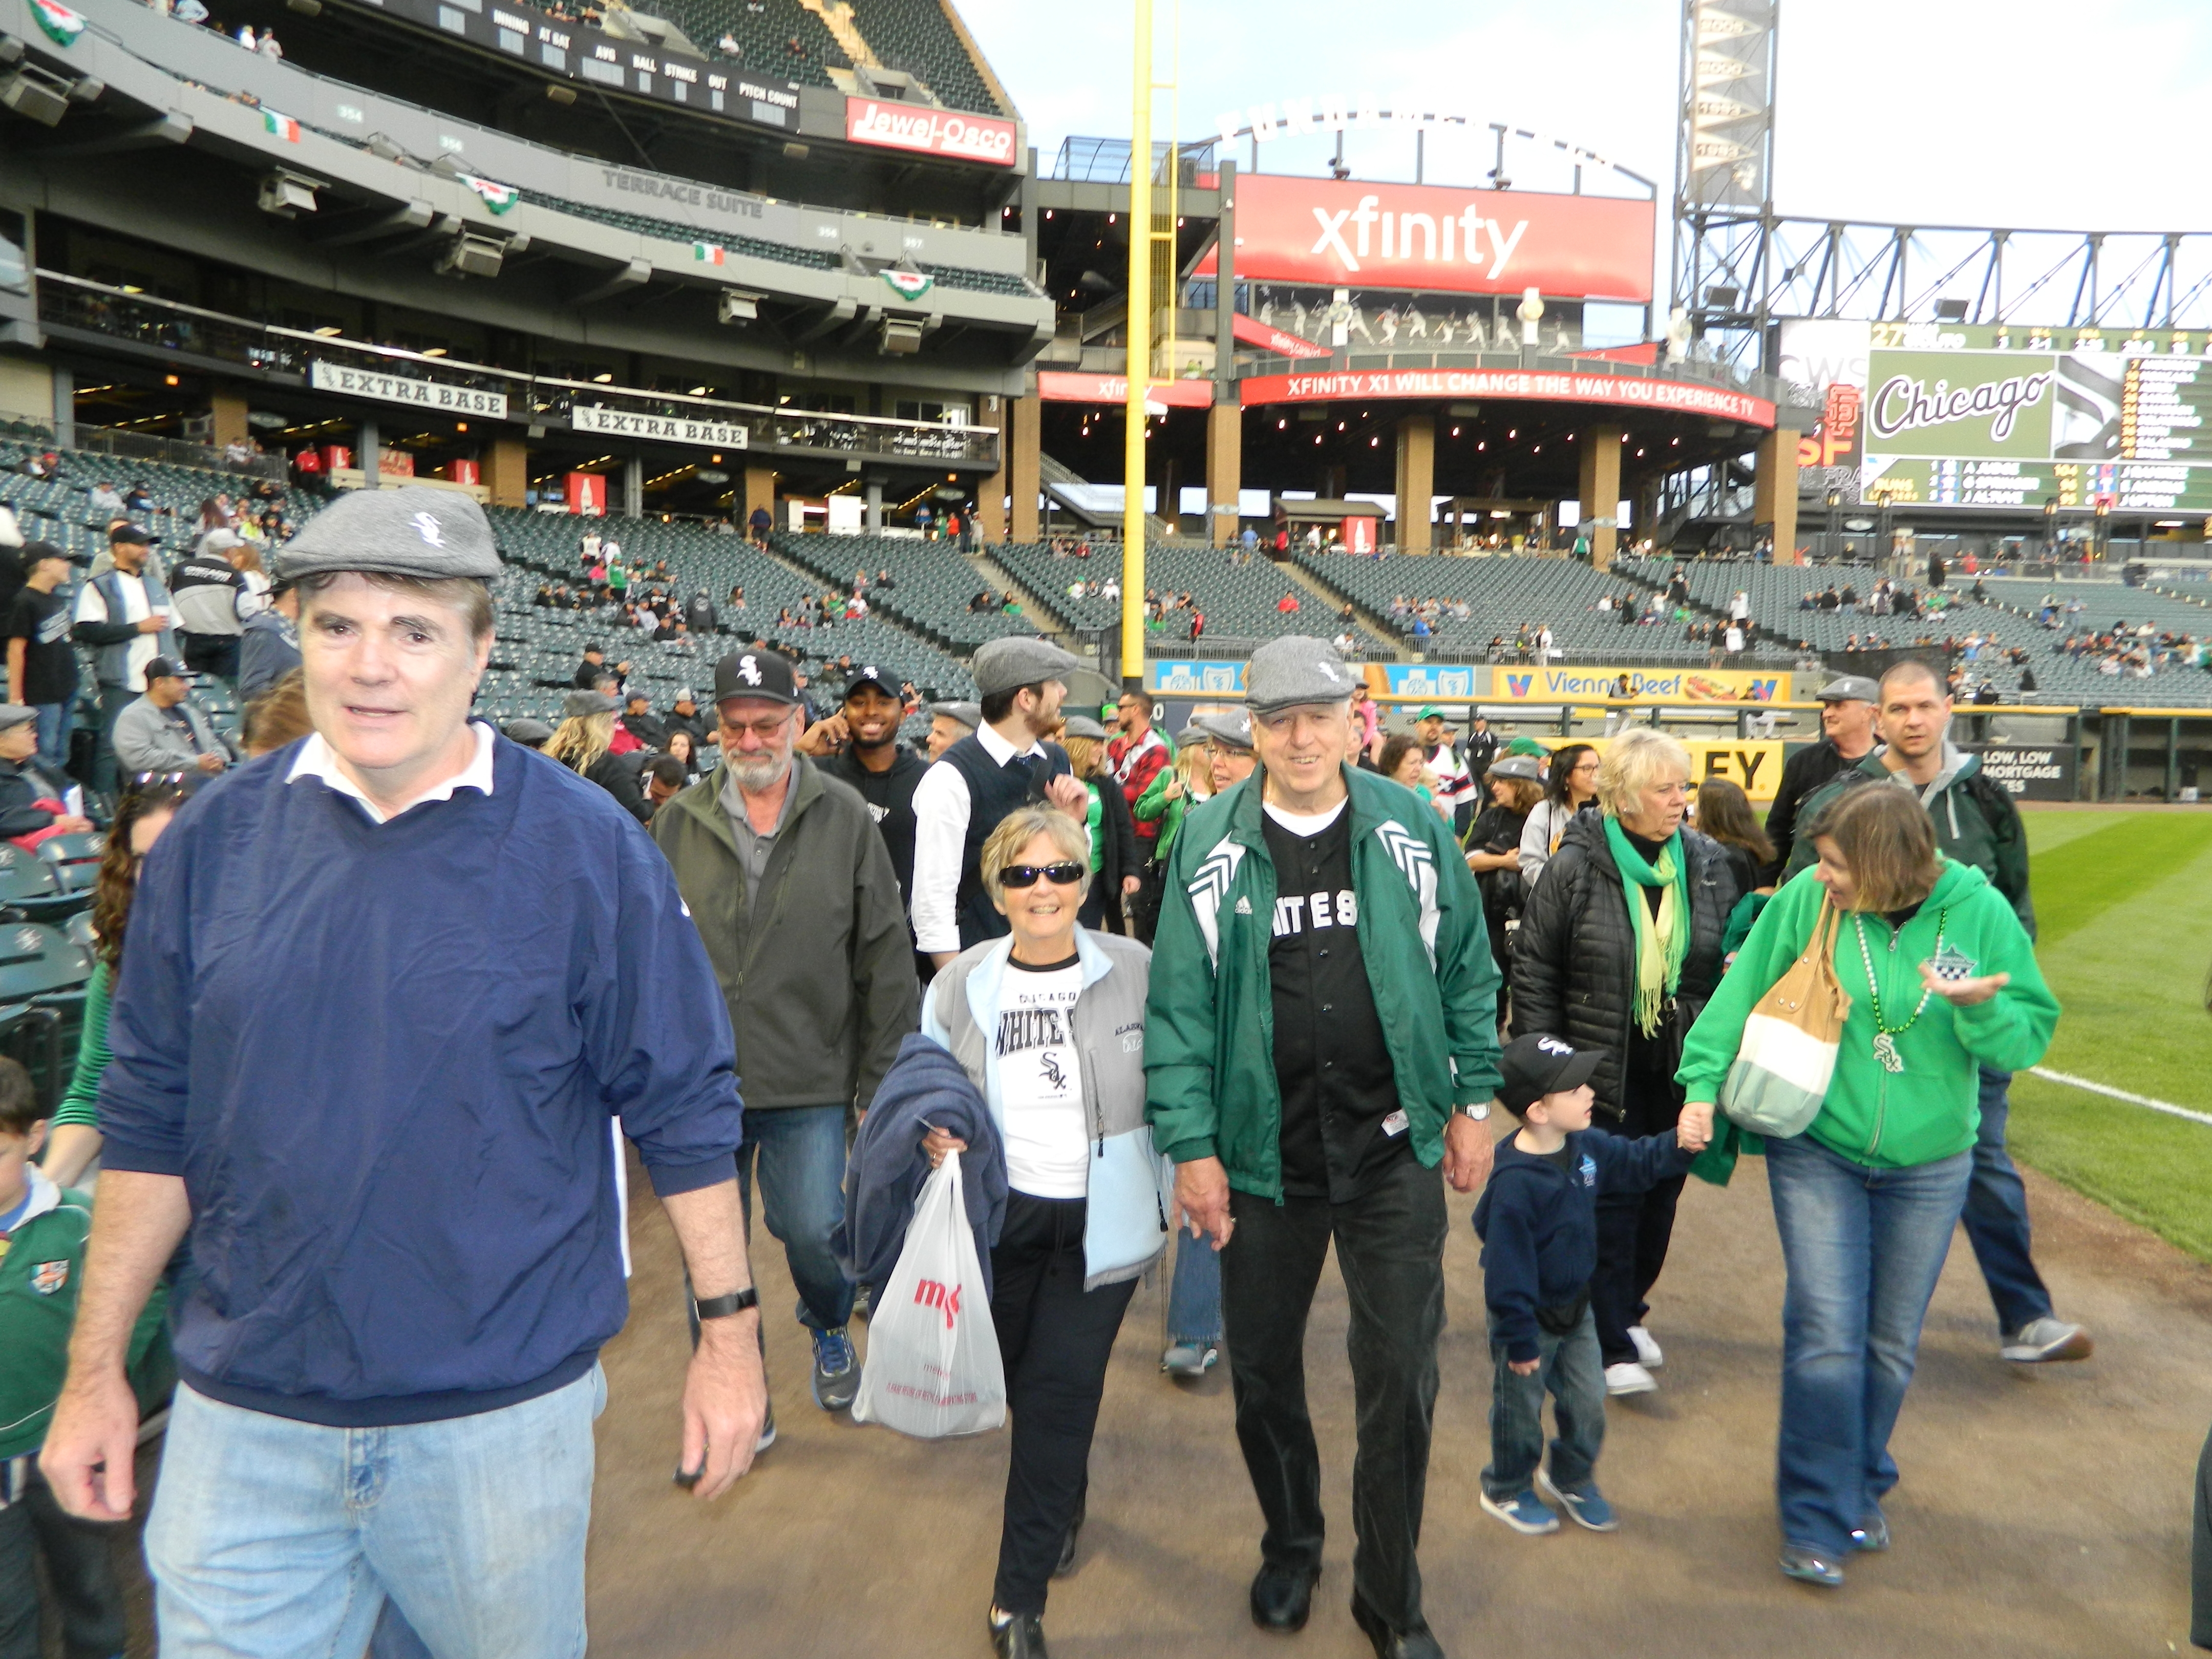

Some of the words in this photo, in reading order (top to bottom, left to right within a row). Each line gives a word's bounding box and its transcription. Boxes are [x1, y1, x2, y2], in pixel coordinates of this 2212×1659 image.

[494, 9, 530, 35] INNING
[539, 27, 551, 42] AT
[552, 31, 570, 50] BAT
[595, 45, 616, 62] AVG
[633, 54, 656, 73] BALL
[665, 62, 697, 83] STRIKE
[708, 74, 727, 90] OUT
[739, 82, 766, 100] PITCH
[768, 90, 797, 109] COUNT
[602, 169, 701, 205] TERRACE
[707, 192, 763, 219] SUITE
[1310, 195, 1529, 280] xfinity
[1870, 323, 1906, 346] 27
[341, 372, 430, 402] EXTRA
[439, 389, 500, 413] BASE
[1287, 375, 1363, 396] XFINITY
[1368, 374, 1389, 392] X1
[1395, 373, 1443, 392] WILL
[1448, 373, 1530, 393] CHANGE
[1535, 375, 1571, 394] THE
[1575, 378, 1614, 397] WAY
[1618, 380, 1653, 400] YOU
[1655, 385, 1739, 413] EXPERIENCE
[1739, 399, 1755, 417] TV
[1869, 369, 2055, 443] Chicago
[597, 413, 677, 436] EXTRA
[685, 424, 742, 444] BASE
[1874, 478, 1913, 492] RUNS
[1545, 671, 1618, 693] Vienn
[1632, 673, 1682, 695] Beef
[1983, 751, 2017, 766] LOW,
[2019, 751, 2052, 764] LOW
[1981, 765, 2061, 779] MORTGAGE
